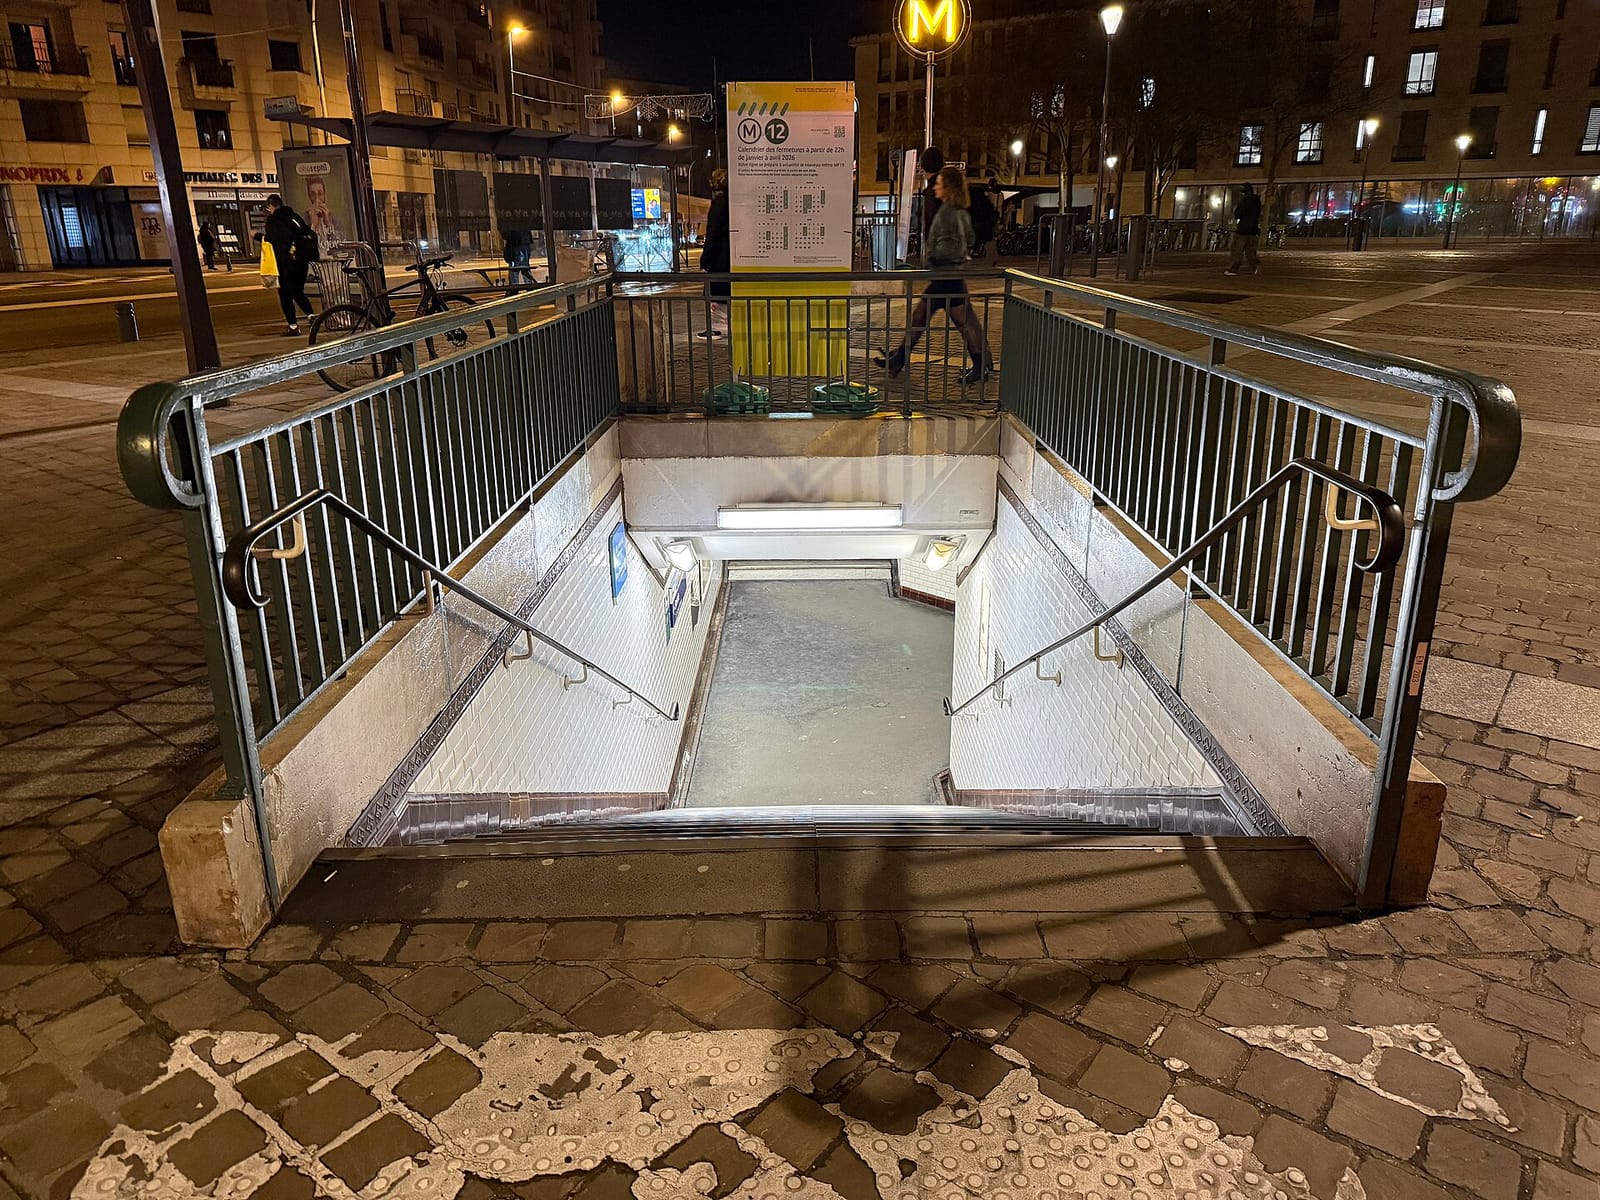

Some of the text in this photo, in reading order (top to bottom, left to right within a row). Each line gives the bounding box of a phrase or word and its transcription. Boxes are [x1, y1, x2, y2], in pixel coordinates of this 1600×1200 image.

[908, 0, 957, 43] M
[742, 123, 786, 139] M 12
[745, 154, 764, 162] janvier
[240, 173, 262, 183] DES
